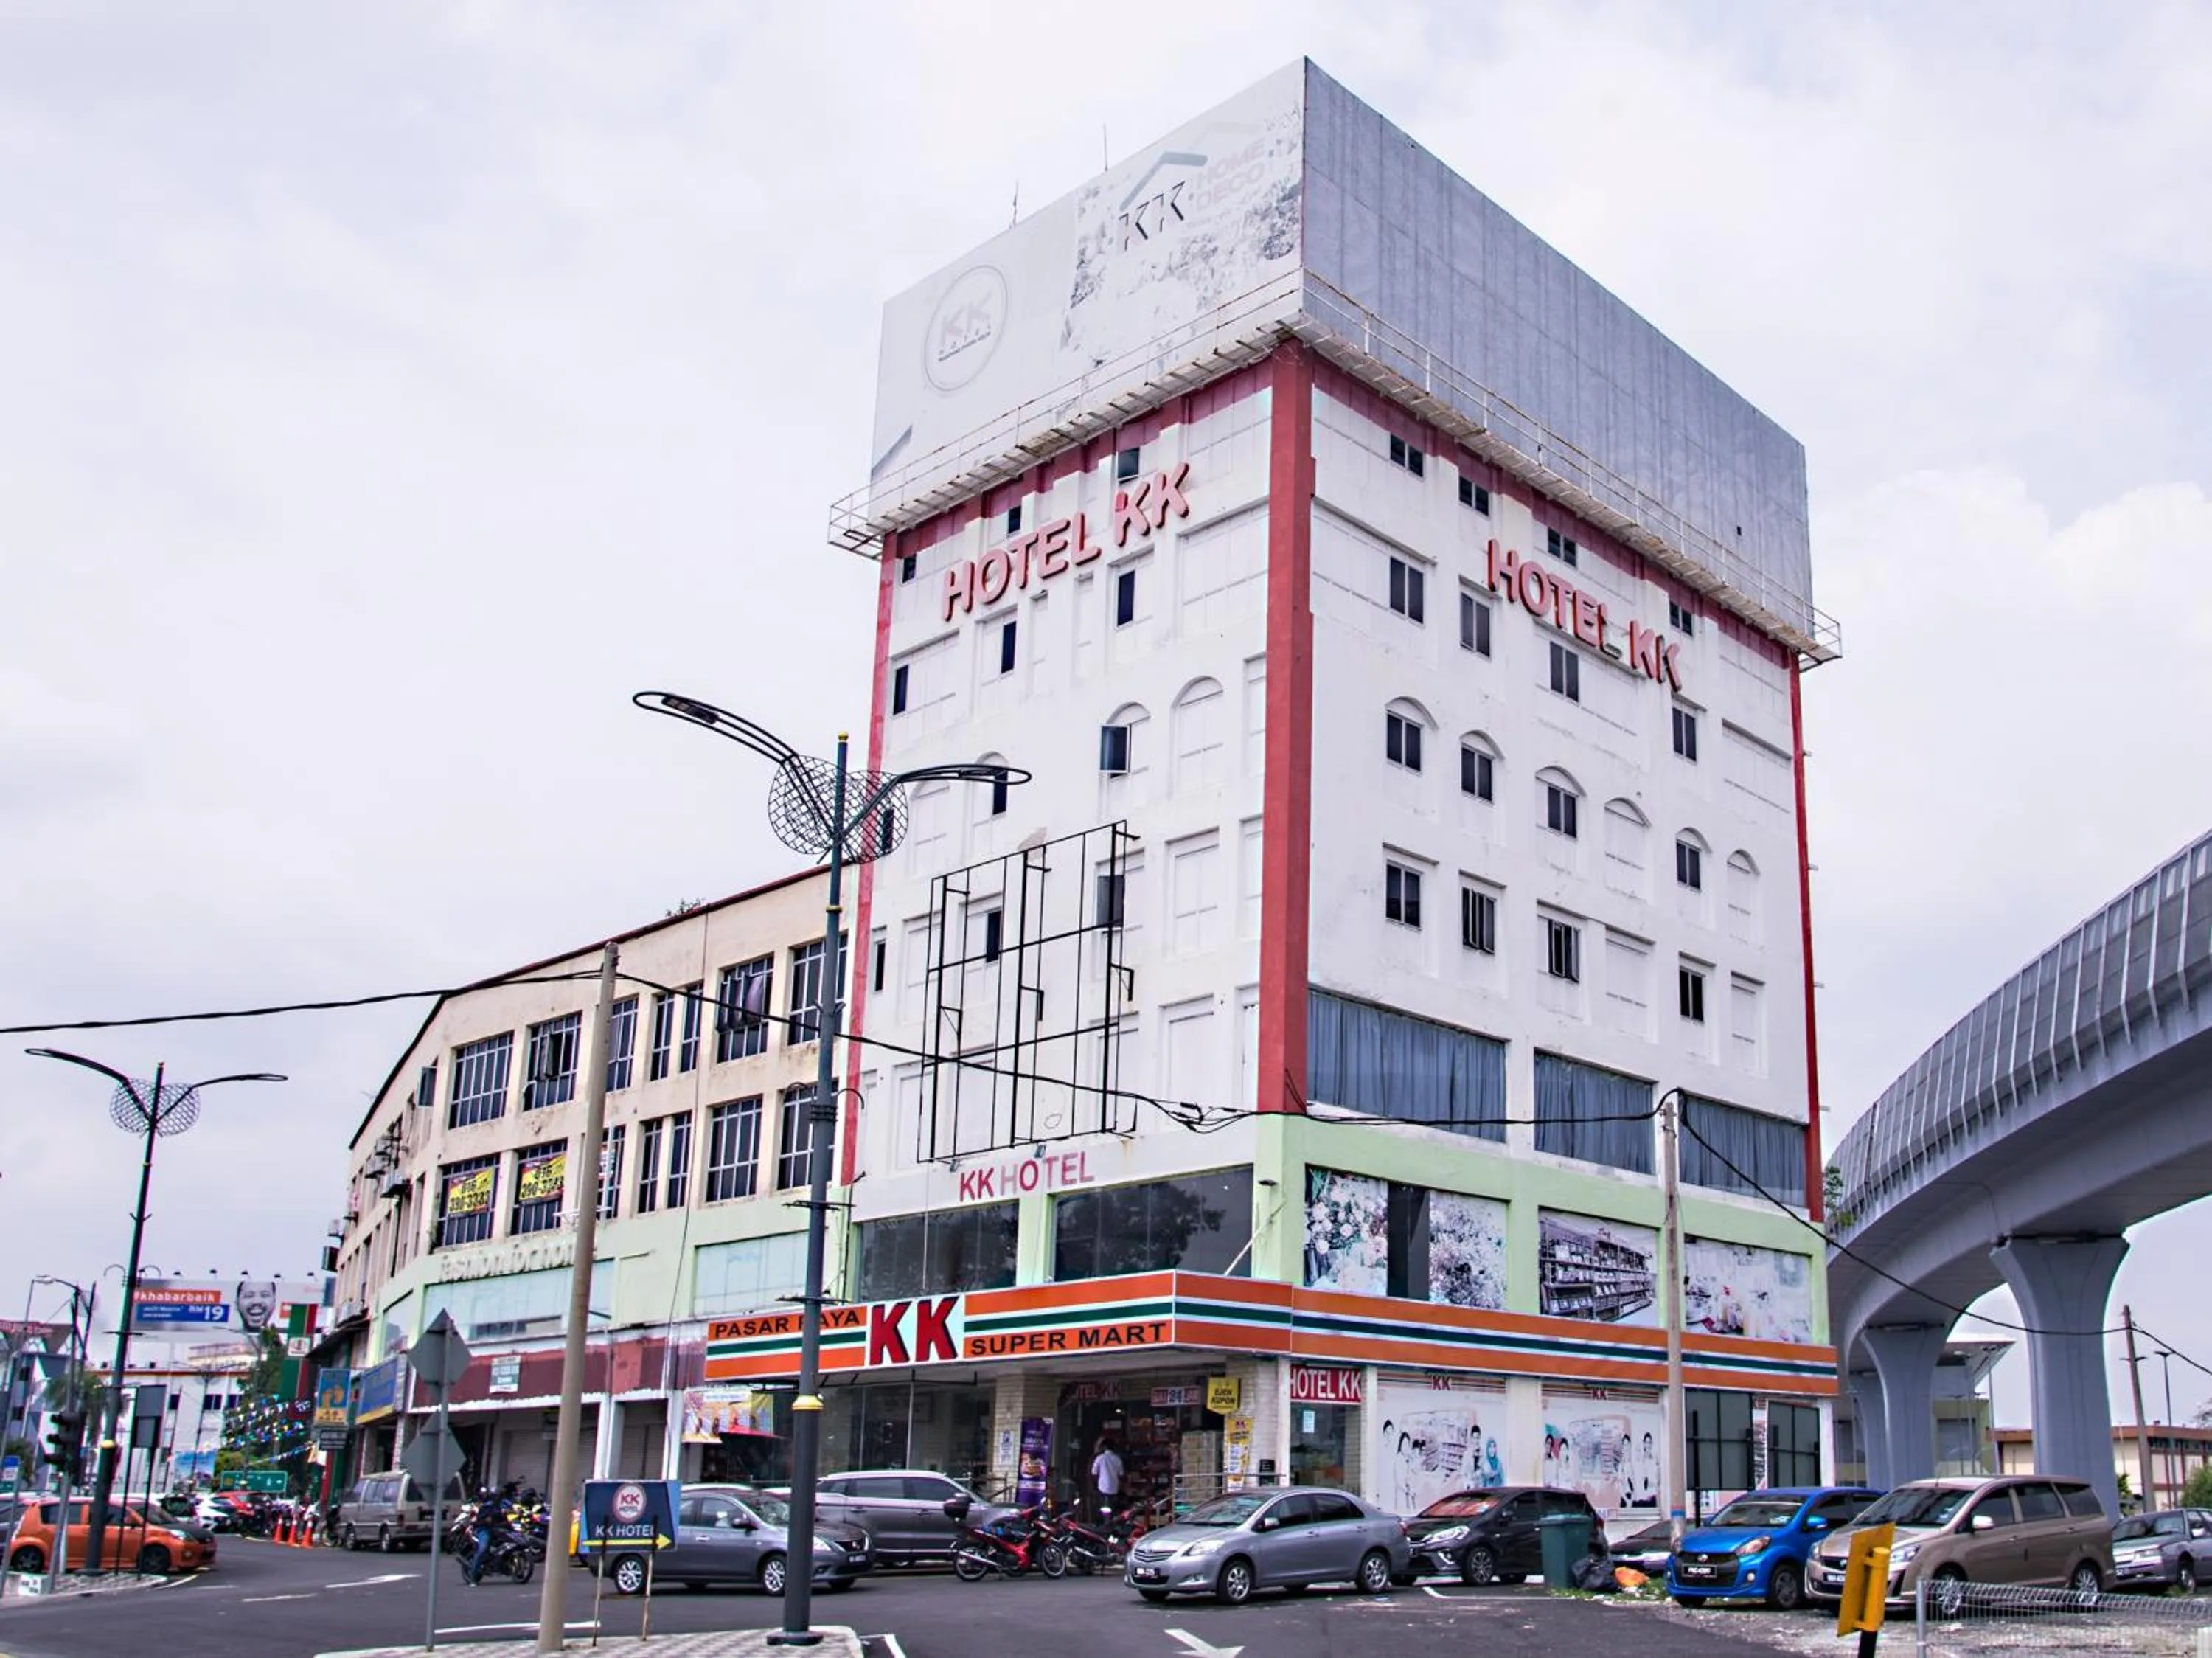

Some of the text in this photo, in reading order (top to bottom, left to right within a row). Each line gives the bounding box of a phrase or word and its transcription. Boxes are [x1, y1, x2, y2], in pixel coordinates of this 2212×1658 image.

[1117, 180, 1186, 252] KK
[942, 462, 1191, 622] HOTEL KK
[1487, 538, 1683, 692] HOTEL KK
[960, 1151, 1095, 1202] KK HOTEL
[204, 1306, 224, 1321] 19
[715, 1318, 788, 1339] PASAR
[869, 1296, 959, 1365] KK
[971, 1322, 1166, 1356] SUPER MART
[1338, 1370, 1362, 1399] KK
[1432, 1376, 1452, 1391] KK
[1591, 1387, 1608, 1400] KK
[620, 1494, 639, 1505] KK
